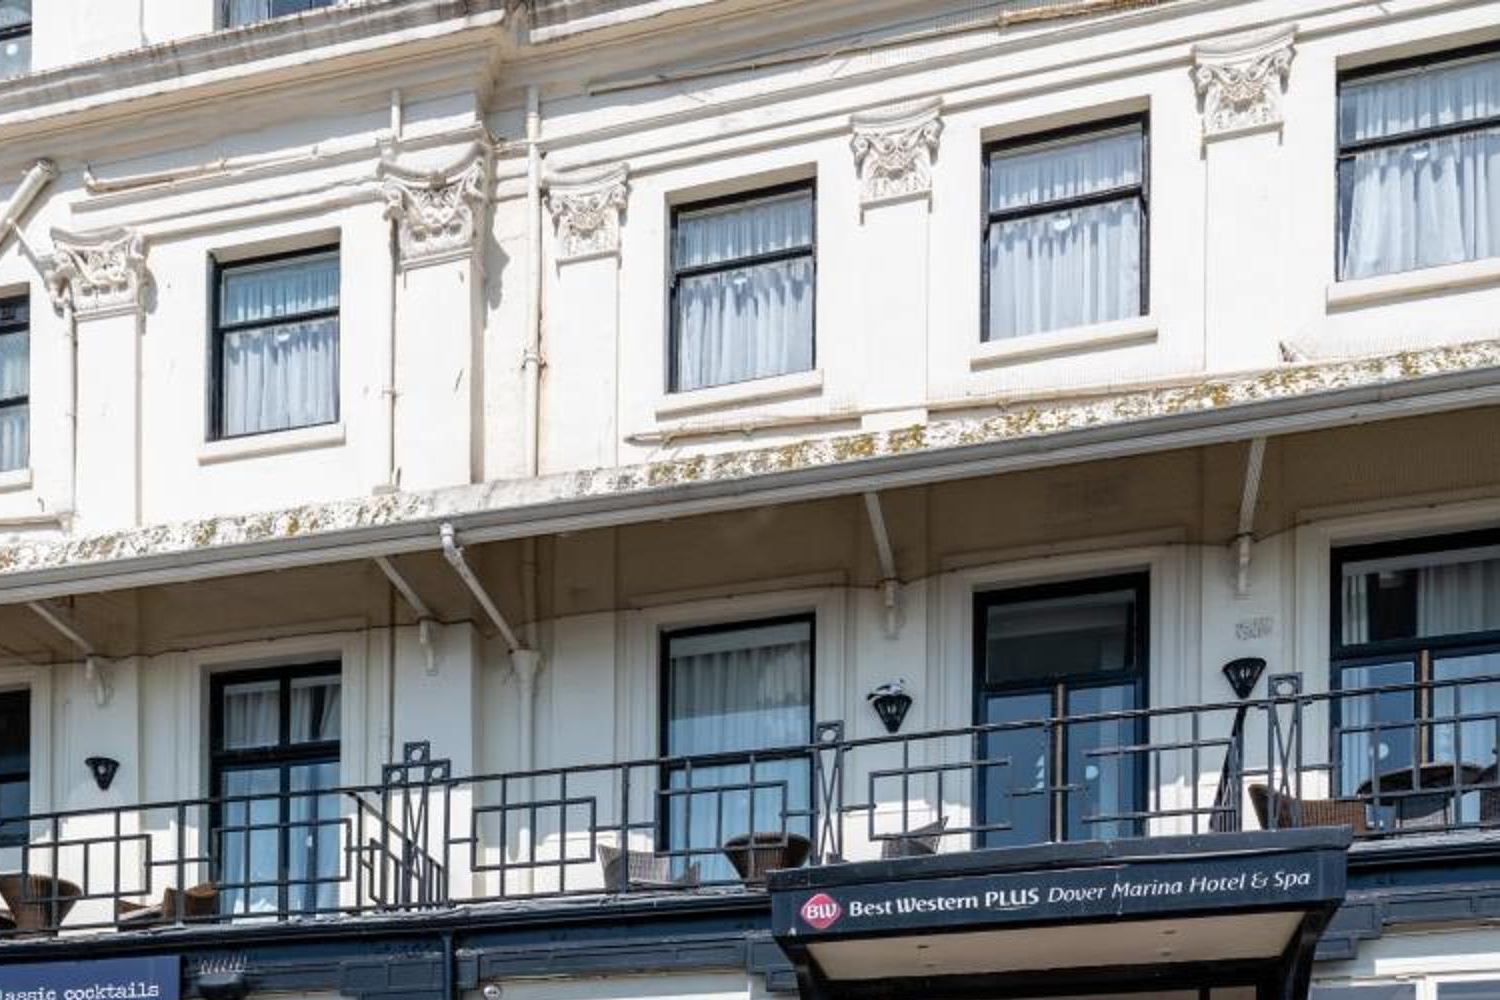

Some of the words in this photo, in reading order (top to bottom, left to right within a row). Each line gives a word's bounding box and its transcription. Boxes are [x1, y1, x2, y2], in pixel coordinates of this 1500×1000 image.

[850, 900, 892, 918] Best
[897, 894, 979, 914] Western
[985, 887, 1040, 907] PLUS
[1048, 886, 1107, 904] Dover
[1112, 879, 1184, 900] Marina
[1190, 872, 1246, 894] Hotel
[1251, 871, 1269, 889] &
[1275, 869, 1312, 891] Spa
[63, 981, 160, 1000] cocktails
